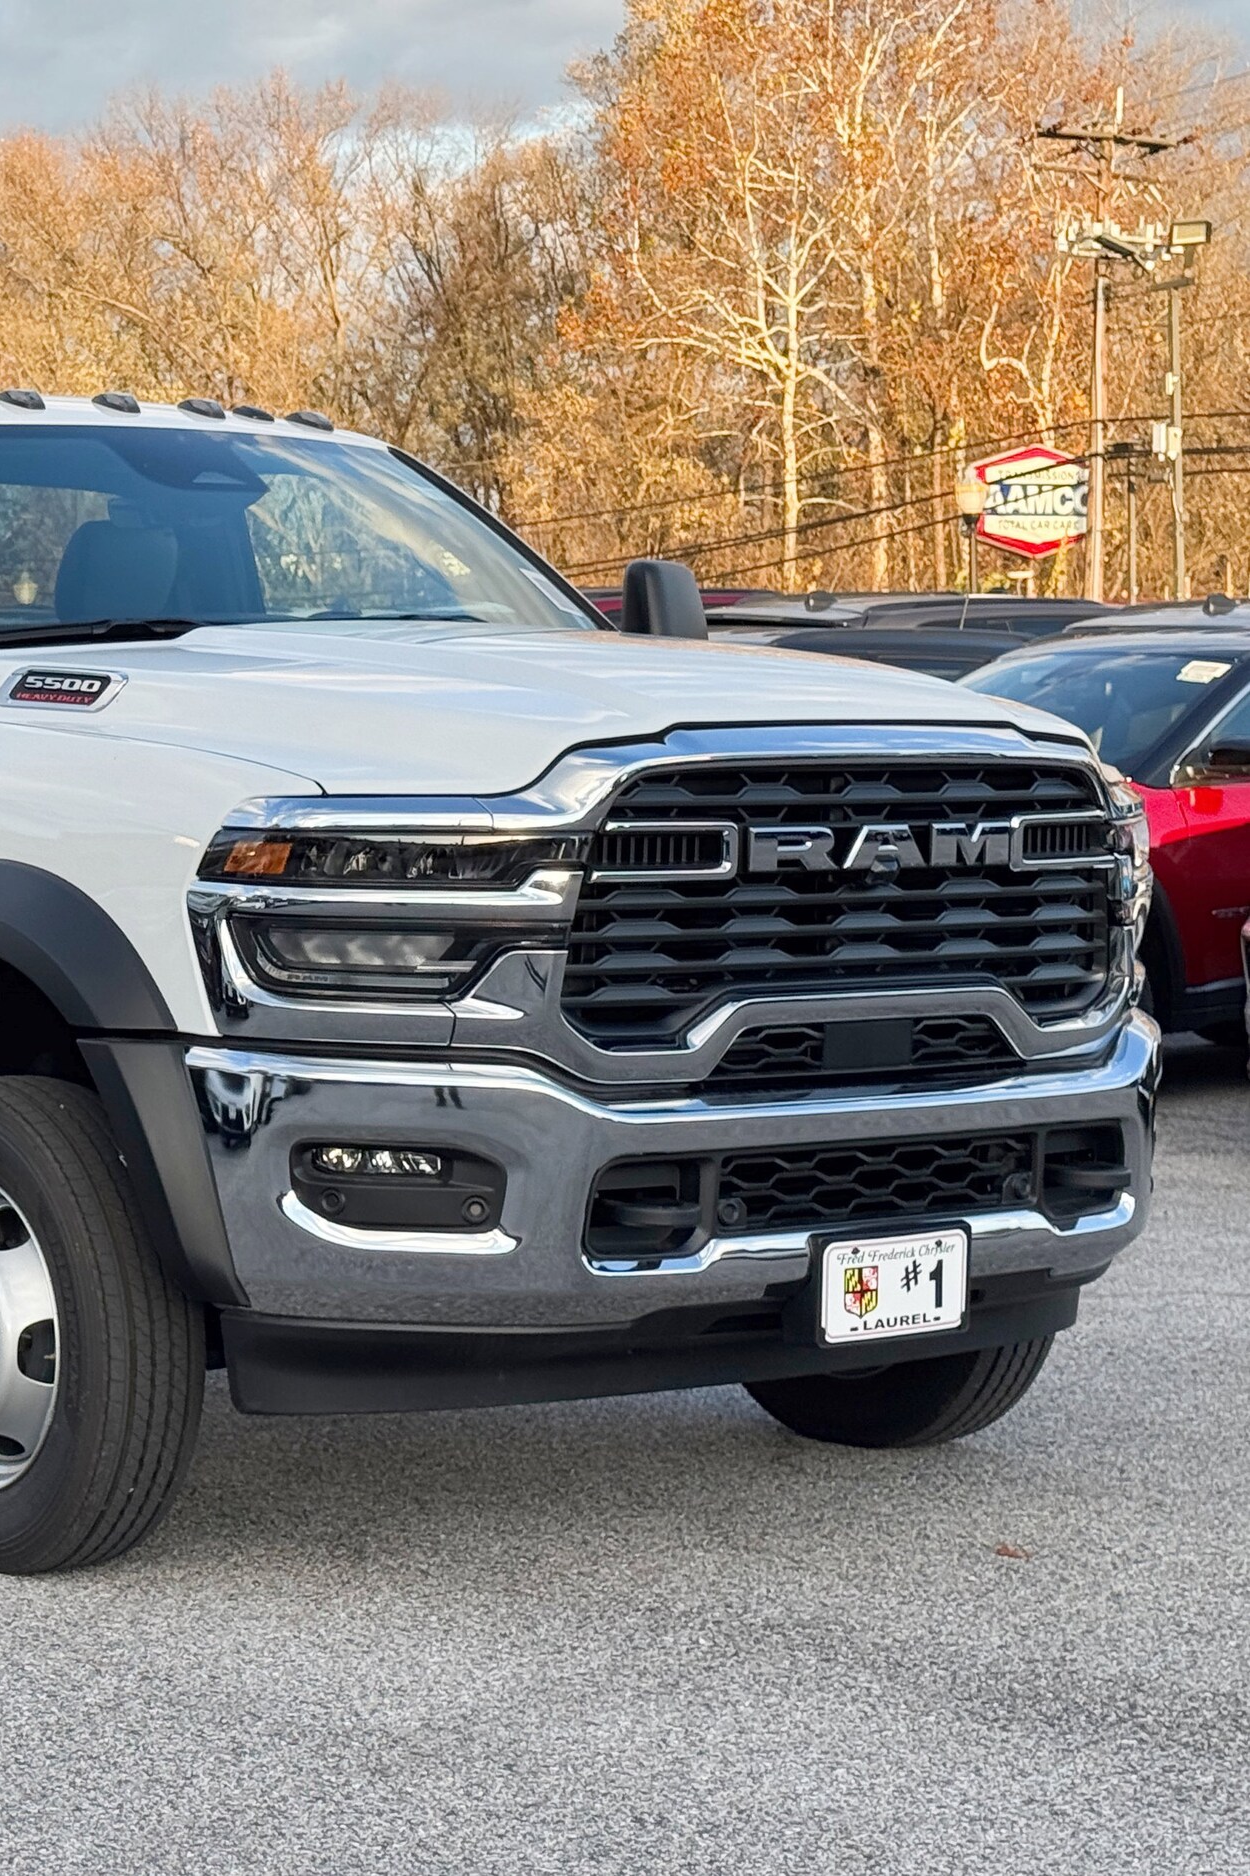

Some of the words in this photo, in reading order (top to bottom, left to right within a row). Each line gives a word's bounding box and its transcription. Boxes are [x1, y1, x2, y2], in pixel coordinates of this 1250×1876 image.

[984, 485, 1088, 515] AAMCO
[24, 676, 102, 693] 5500
[16, 692, 58, 701] HEAVY
[58, 694, 94, 704] DUTY
[748, 821, 1011, 873] RAM
[837, 1252, 865, 1265] Fred
[868, 1248, 916, 1263] Frederick
[918, 1242, 956, 1257] Chrysler
[901, 1259, 943, 1309] #1
[863, 1313, 931, 1331] LAUREL
